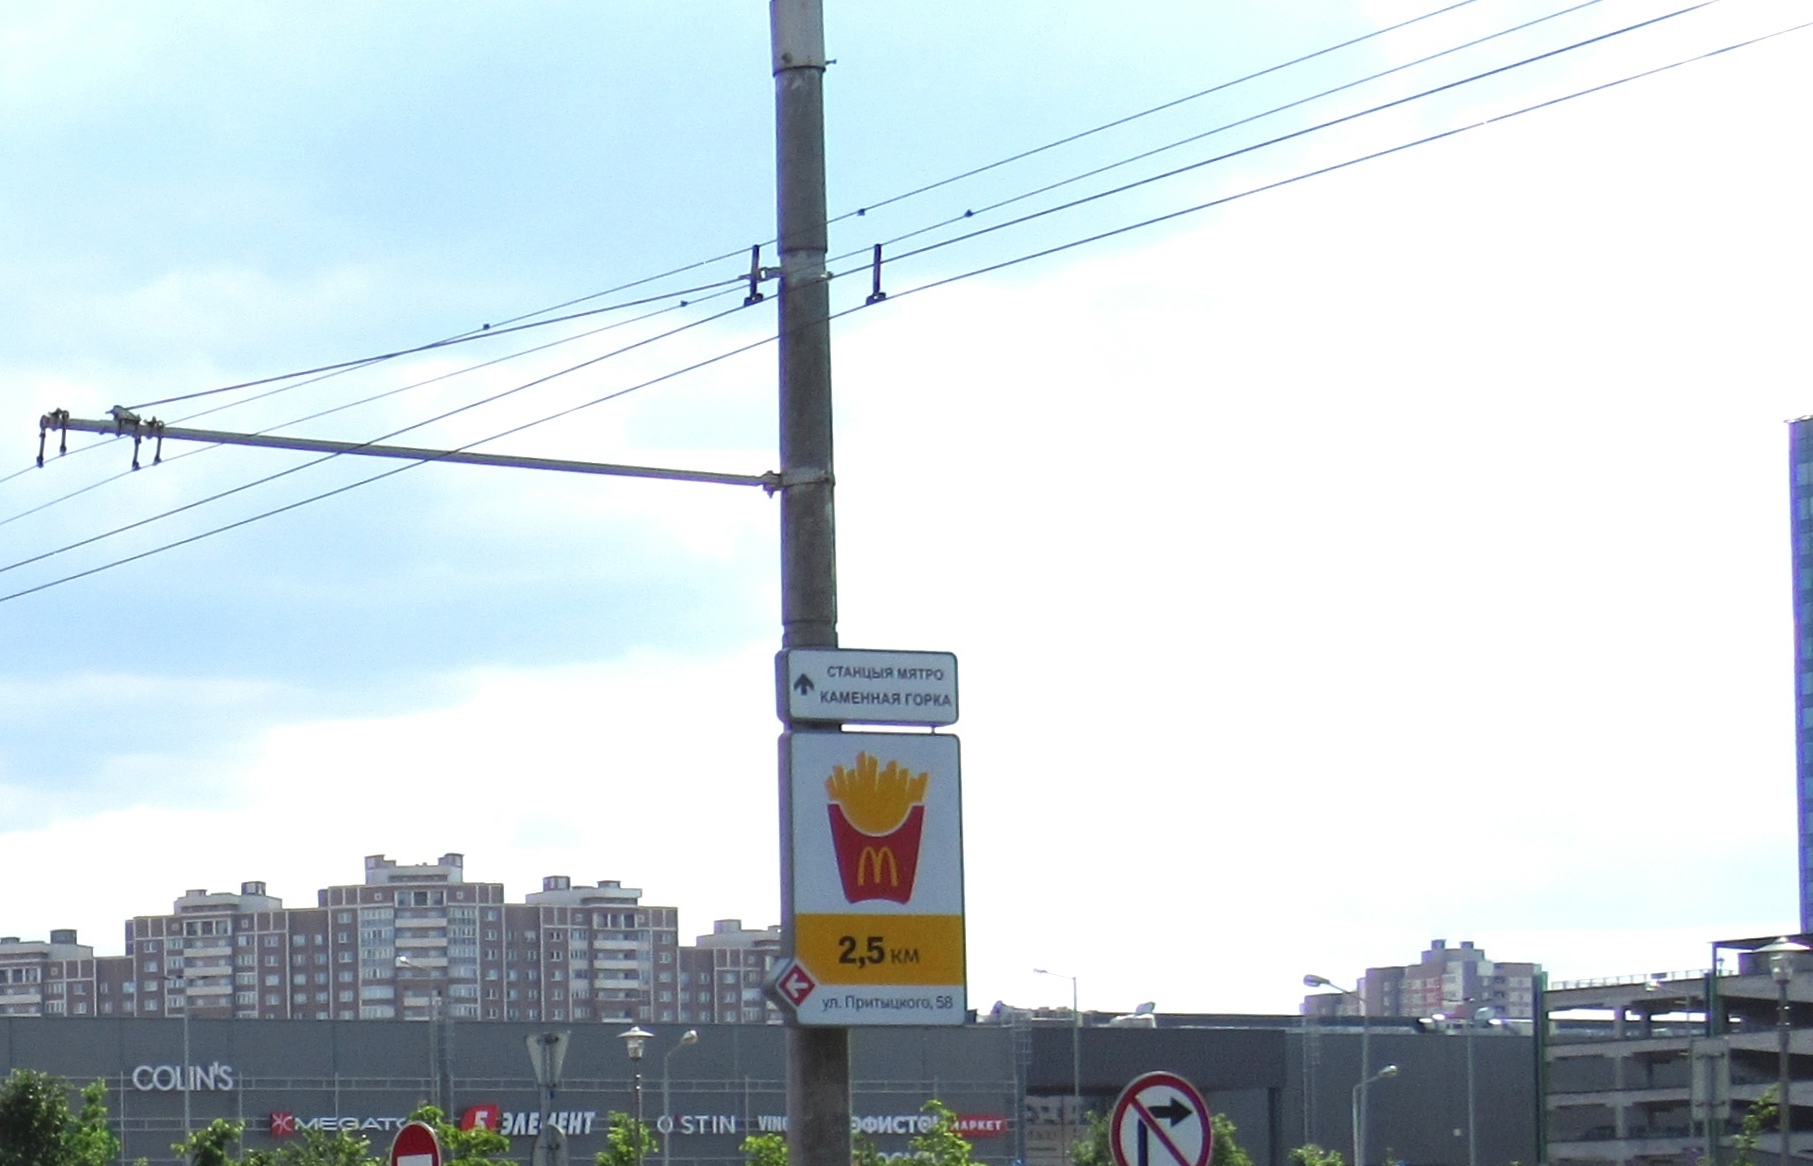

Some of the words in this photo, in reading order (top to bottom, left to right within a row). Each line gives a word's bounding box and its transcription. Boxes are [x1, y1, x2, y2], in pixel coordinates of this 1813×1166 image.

[827, 666, 893, 680] СТАНЦЫЯ
[897, 668, 944, 681] МЯТРО
[820, 691, 900, 705] КАМЕННАЯ
[905, 693, 951, 706] ГОРКА
[838, 935, 885, 969] 2,5
[822, 997, 841, 1012] ул.
[845, 995, 933, 1012] Притыцкого,
[936, 995, 953, 1009] 58
[132, 1061, 233, 1091] COLIN'S
